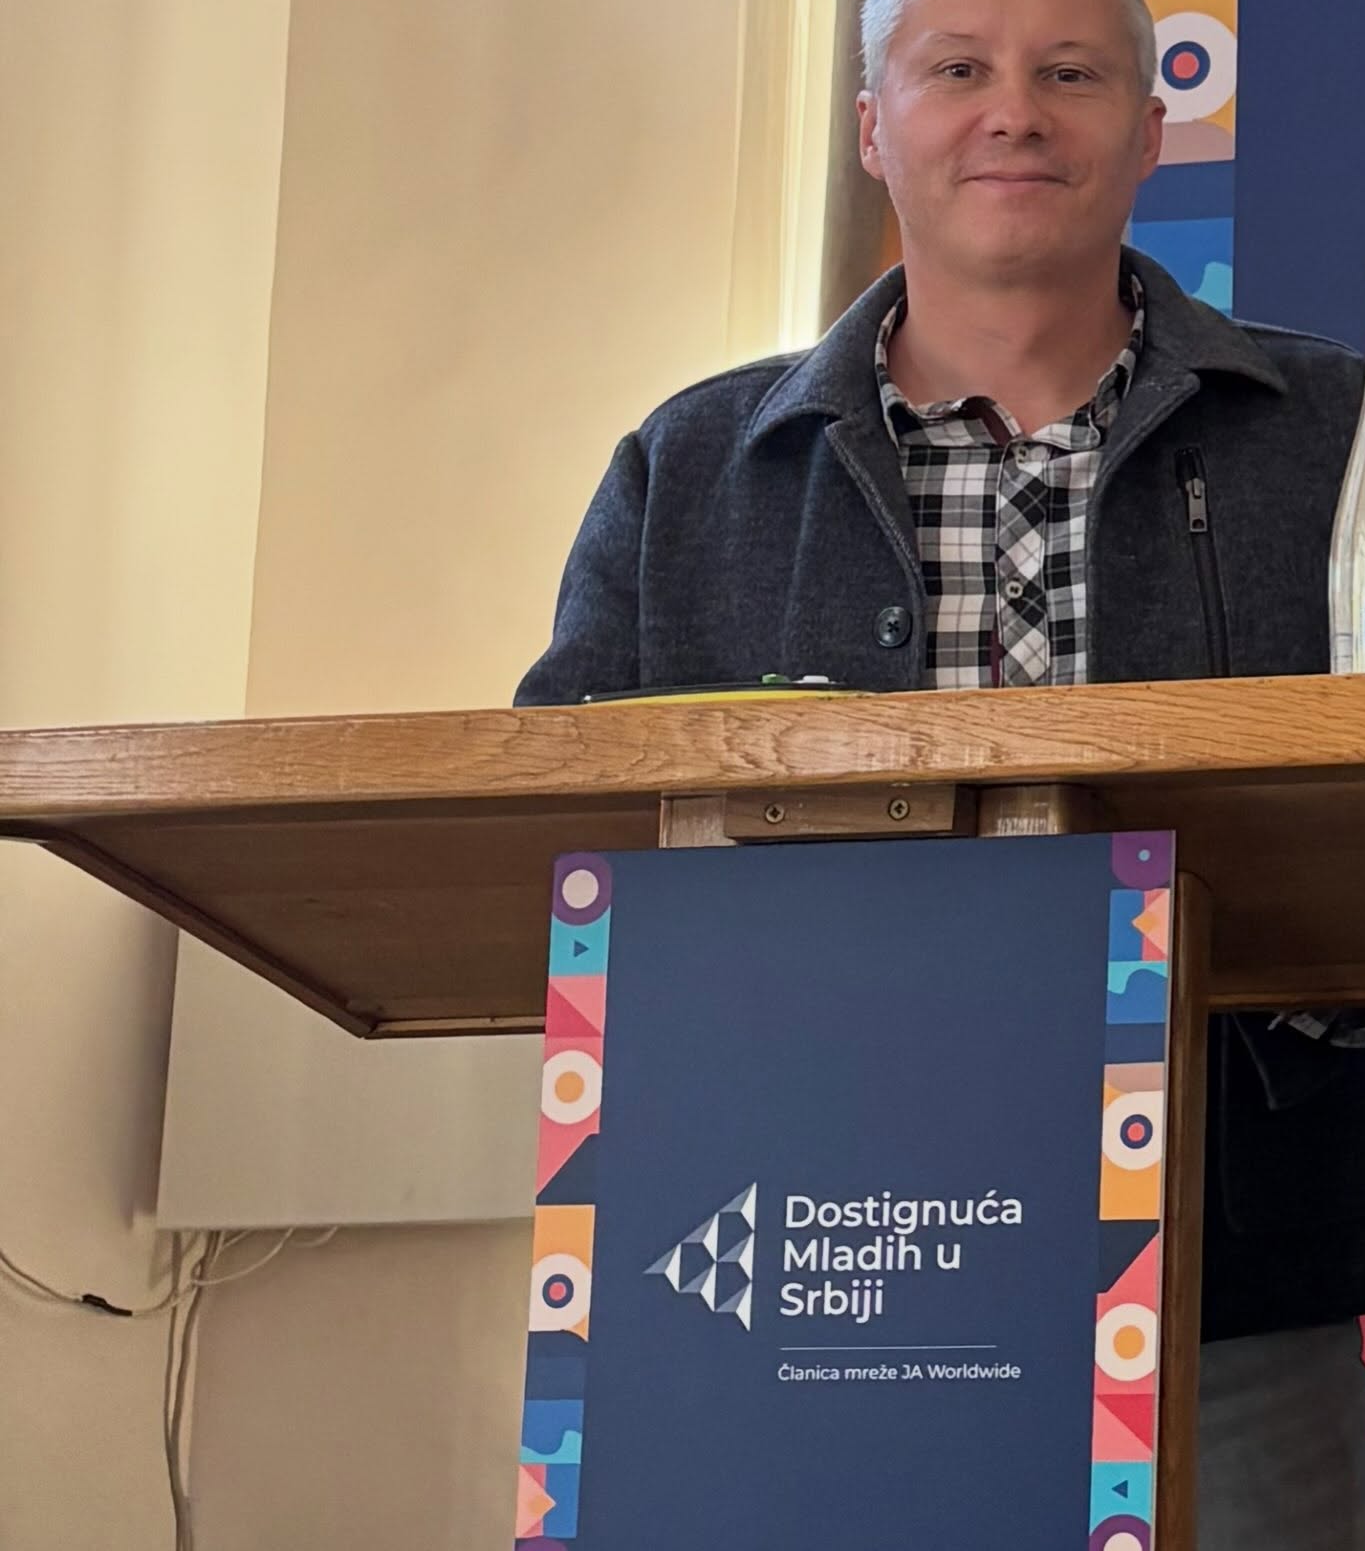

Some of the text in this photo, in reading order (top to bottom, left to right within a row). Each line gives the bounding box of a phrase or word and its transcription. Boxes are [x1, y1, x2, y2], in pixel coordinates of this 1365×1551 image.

[785, 1189, 1022, 1235] Dostignuća
[783, 1234, 961, 1272] Mladih u
[780, 1278, 884, 1324] Srbiji
[777, 1362, 1022, 1381] Članica mreže JA Worldwide
